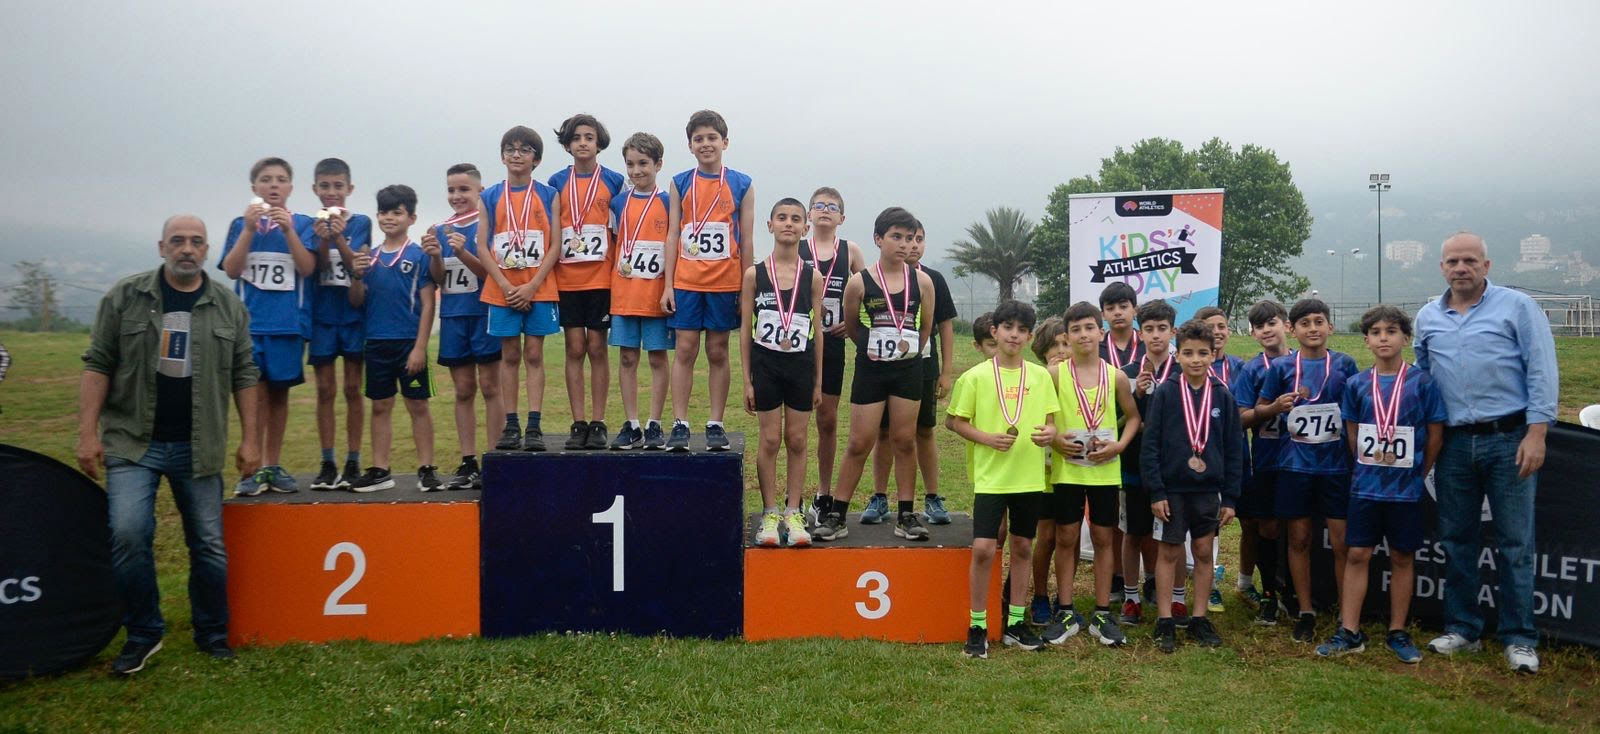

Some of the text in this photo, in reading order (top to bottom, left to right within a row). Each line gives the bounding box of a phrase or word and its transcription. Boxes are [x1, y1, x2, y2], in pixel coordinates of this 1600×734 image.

[251, 264, 285, 285] 178
[1103, 251, 1181, 275] ATHLETICS
[1124, 267, 1181, 296] DAY
[761, 322, 801, 349] 206
[1295, 414, 1338, 437] 274
[592, 494, 625, 592] 1
[323, 541, 367, 616] 2
[855, 571, 891, 619] 3
